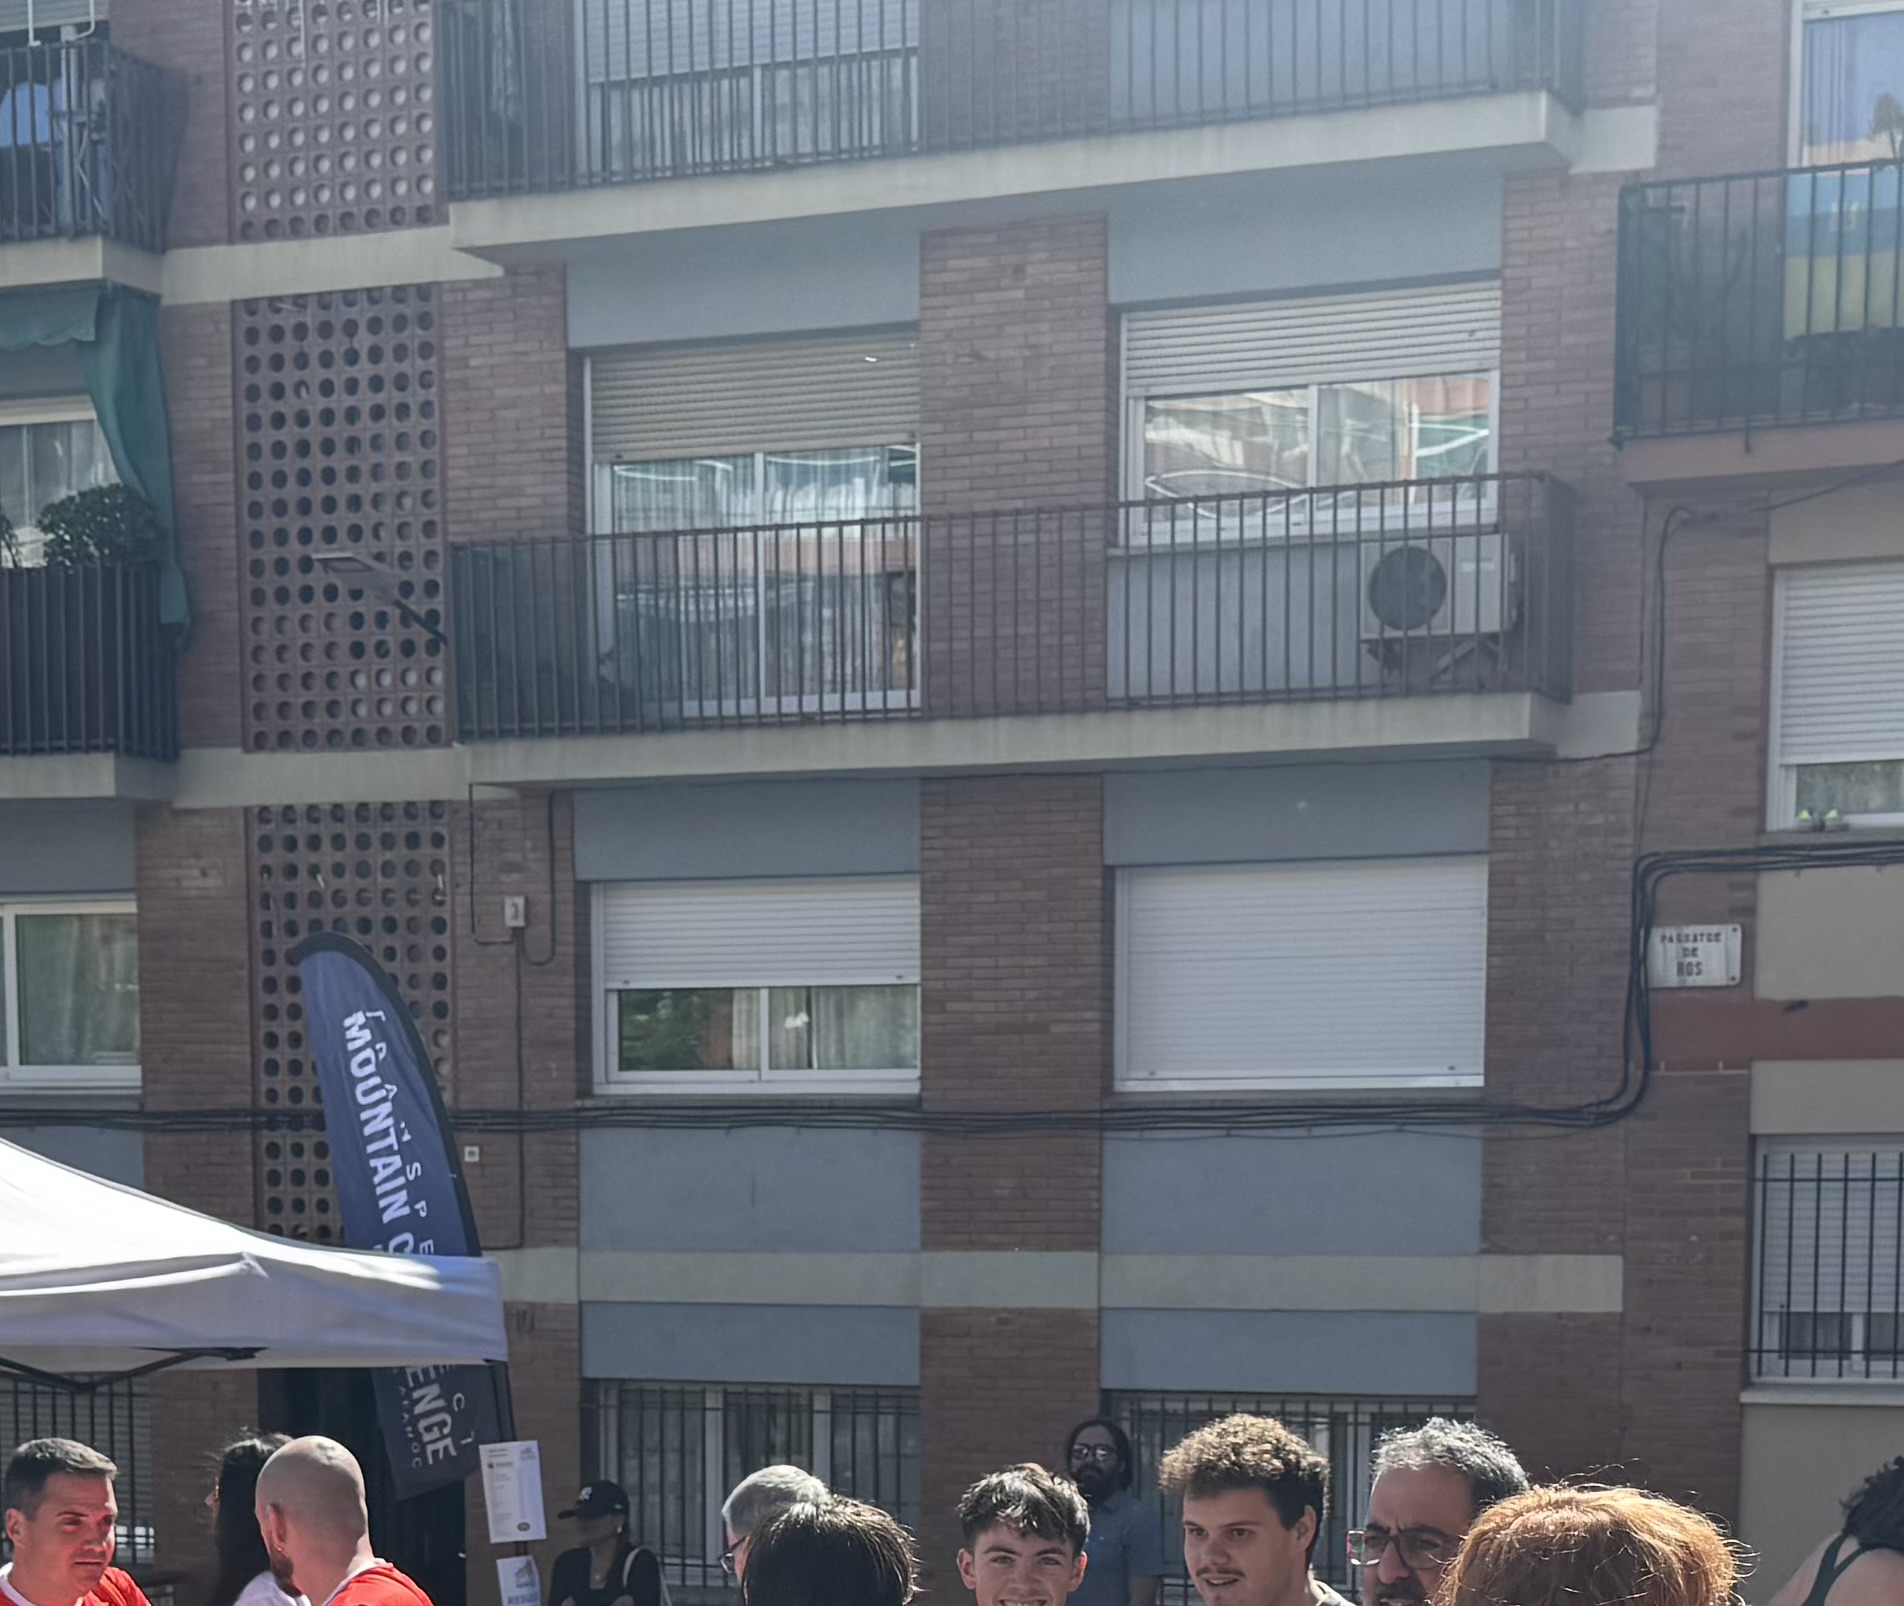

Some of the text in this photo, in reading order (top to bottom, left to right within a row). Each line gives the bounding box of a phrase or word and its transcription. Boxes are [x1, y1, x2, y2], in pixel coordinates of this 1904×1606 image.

[1660, 932, 1722, 944] PASSATGE
[1682, 947, 1699, 958] DE
[1676, 961, 1703, 977] ROS
[344, 1011, 411, 1224] MOUNTAIN
